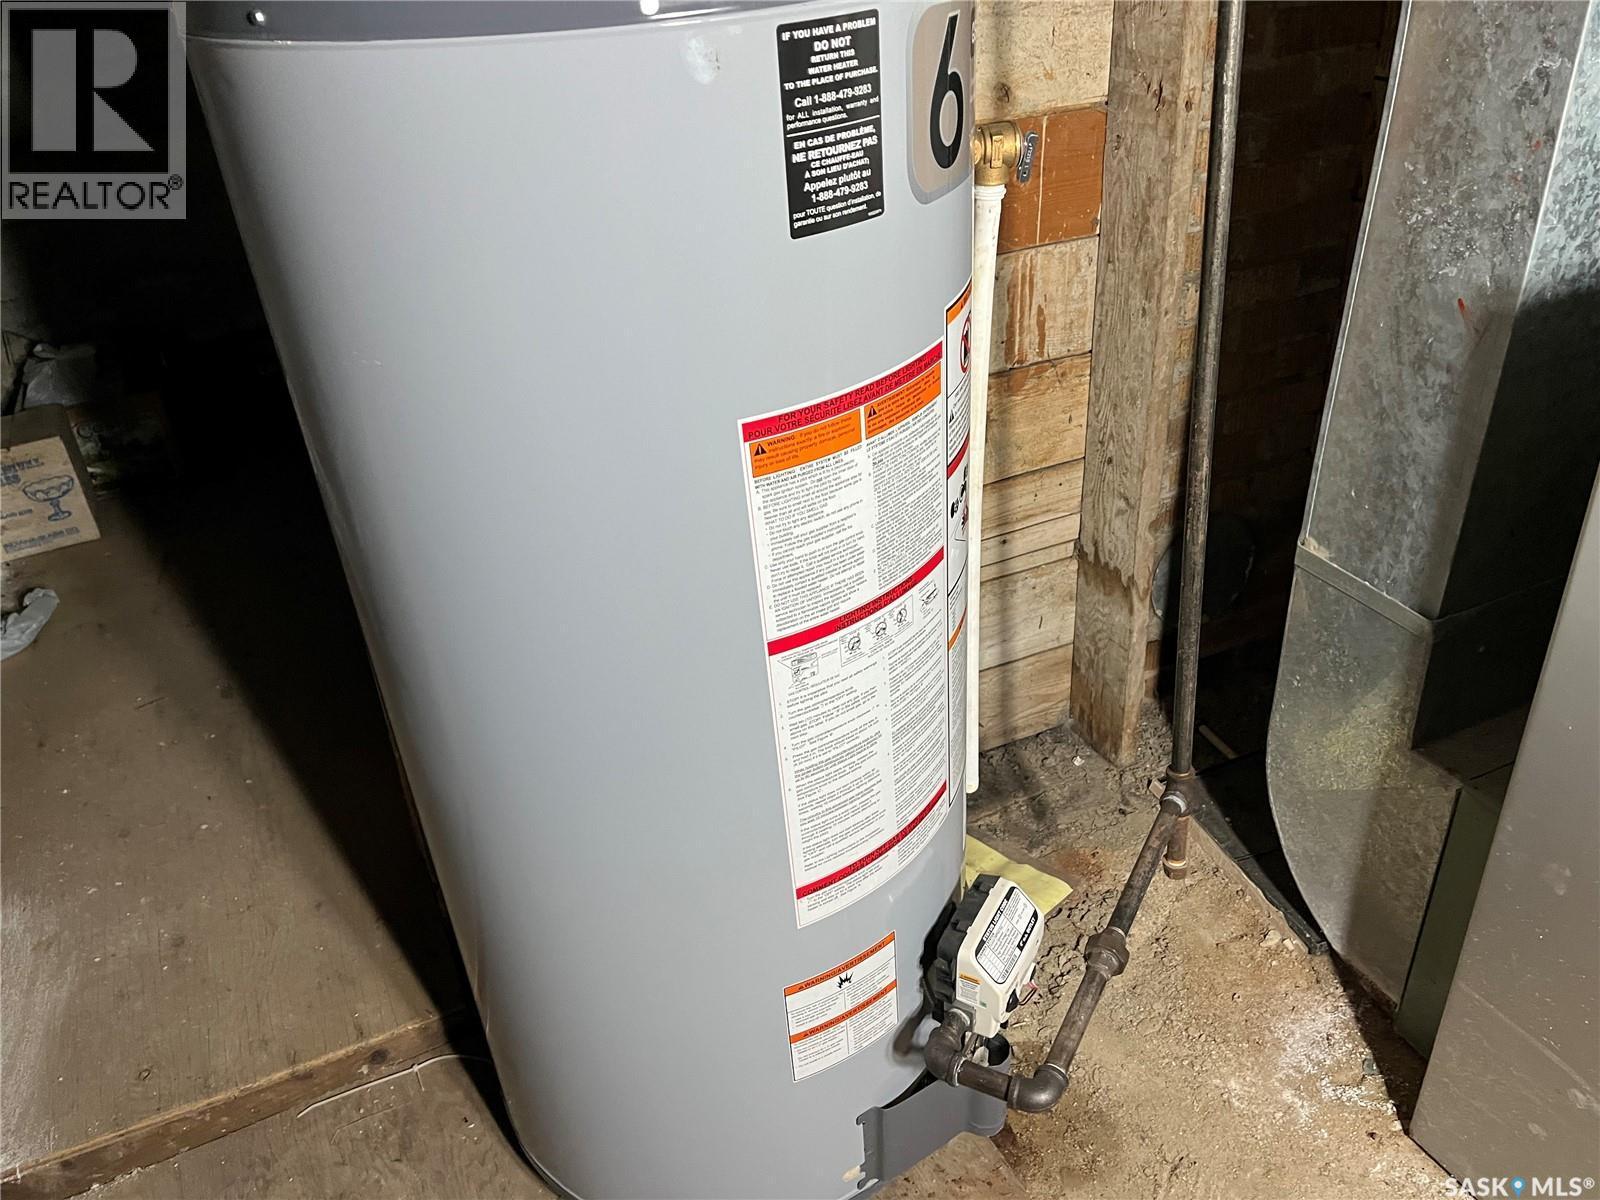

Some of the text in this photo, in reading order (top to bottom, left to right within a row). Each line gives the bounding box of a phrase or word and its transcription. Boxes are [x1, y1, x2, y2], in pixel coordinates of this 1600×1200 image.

[782, 17, 876, 41] IF YOU HAVE A PROBLEM
[814, 36, 851, 51] DO NOT
[810, 49, 855, 63] RETURN THIS
[808, 60, 858, 75] WATER HEATER
[796, 80, 810, 88] THE
[812, 75, 834, 85] PLACE
[794, 83, 872, 107] Call 1-888-479-9283
[930, 10, 964, 170] 6
[846, 100, 868, 109] warranty
[786, 118, 821, 130] performance
[794, 141, 805, 149] EN
[807, 137, 824, 147] CAS
[825, 134, 835, 143] DE
[792, 136, 878, 163] NE RETOURNEZ PAS
[822, 150, 864, 166] CHAUFFE-EAU
[812, 169, 826, 177] SON
[827, 164, 842, 174] LIEU
[804, 177, 837, 192] Appelez
[862, 169, 871, 178] au
[811, 181, 868, 202] 1-888-479-9283
[793, 211, 806, 220] pour
[806, 206, 826, 216] TOUTE
[794, 218, 815, 229] garantie
[778, 412, 796, 422] FOR
[799, 405, 821, 416] YOUR
[824, 394, 851, 408] SAFETY
[855, 384, 874, 396] READ
[748, 427, 772, 439] POUR
[775, 419, 801, 431] VOTRE
[843, 398, 861, 409] LISEZ
[863, 387, 885, 401] AVANT
